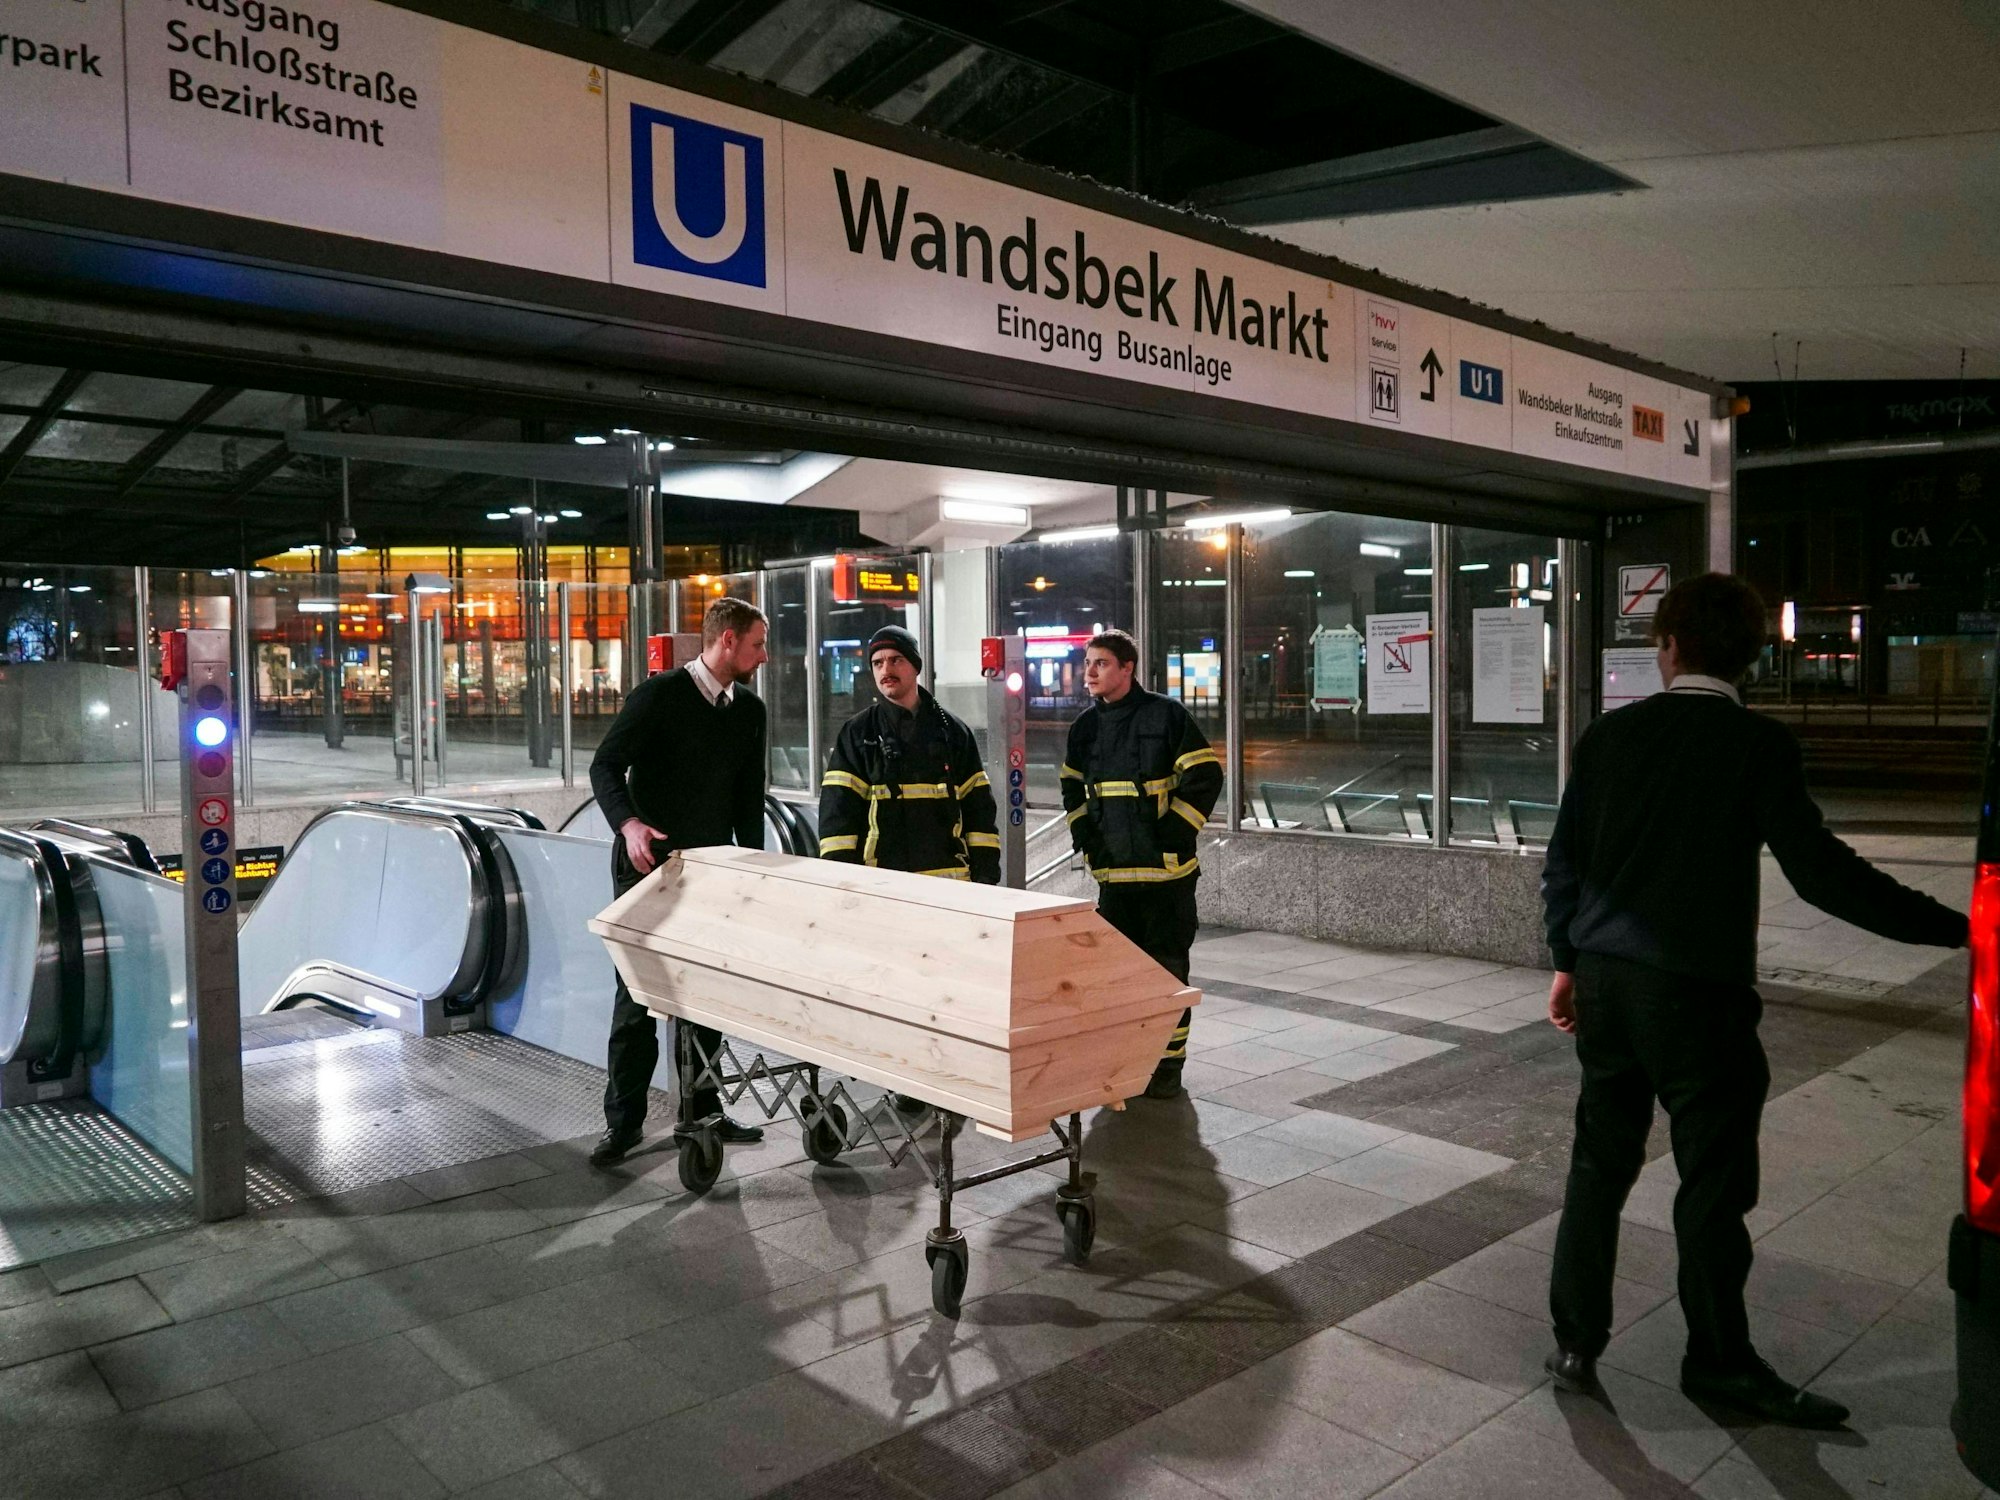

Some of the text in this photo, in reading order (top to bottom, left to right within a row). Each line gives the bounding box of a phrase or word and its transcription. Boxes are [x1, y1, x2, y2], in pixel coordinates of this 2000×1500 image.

[168, 0, 339, 51] usgang
[166, 19, 418, 109] Schloßstraße
[169, 68, 384, 146] Bezirksamt
[651, 122, 747, 264] U
[833, 167, 1329, 363] Wandsbek Markt
[997, 304, 1233, 386] Eingang Busanlage
[1470, 367, 1494, 397] U1
[1588, 382, 1623, 409] Ausgang
[1518, 388, 1623, 429] Wandsbeker Marktstraße
[1634, 409, 1664, 436] TAXI
[1555, 421, 1624, 451] Einkaufszentrum
